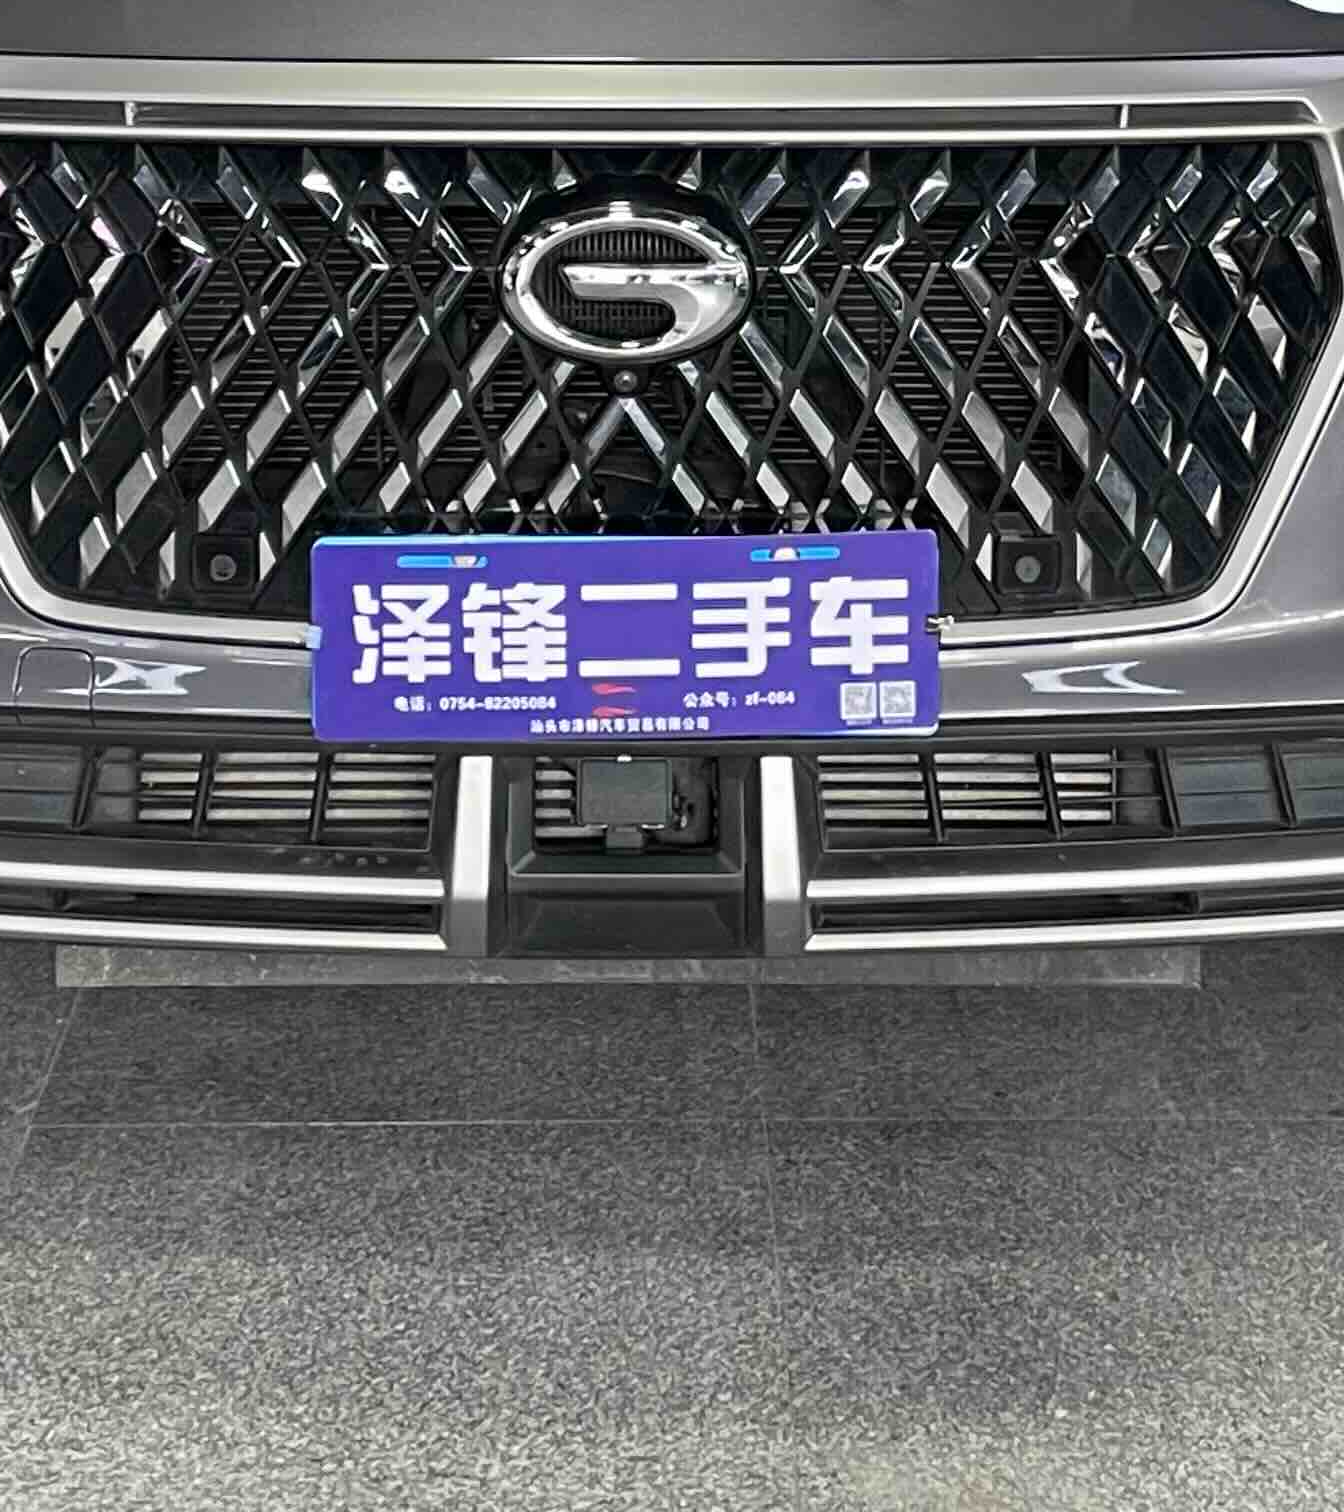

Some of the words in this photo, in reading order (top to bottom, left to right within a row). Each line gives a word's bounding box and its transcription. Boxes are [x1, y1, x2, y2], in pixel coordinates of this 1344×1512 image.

[352, 576, 910, 684] 泽锋二手车
